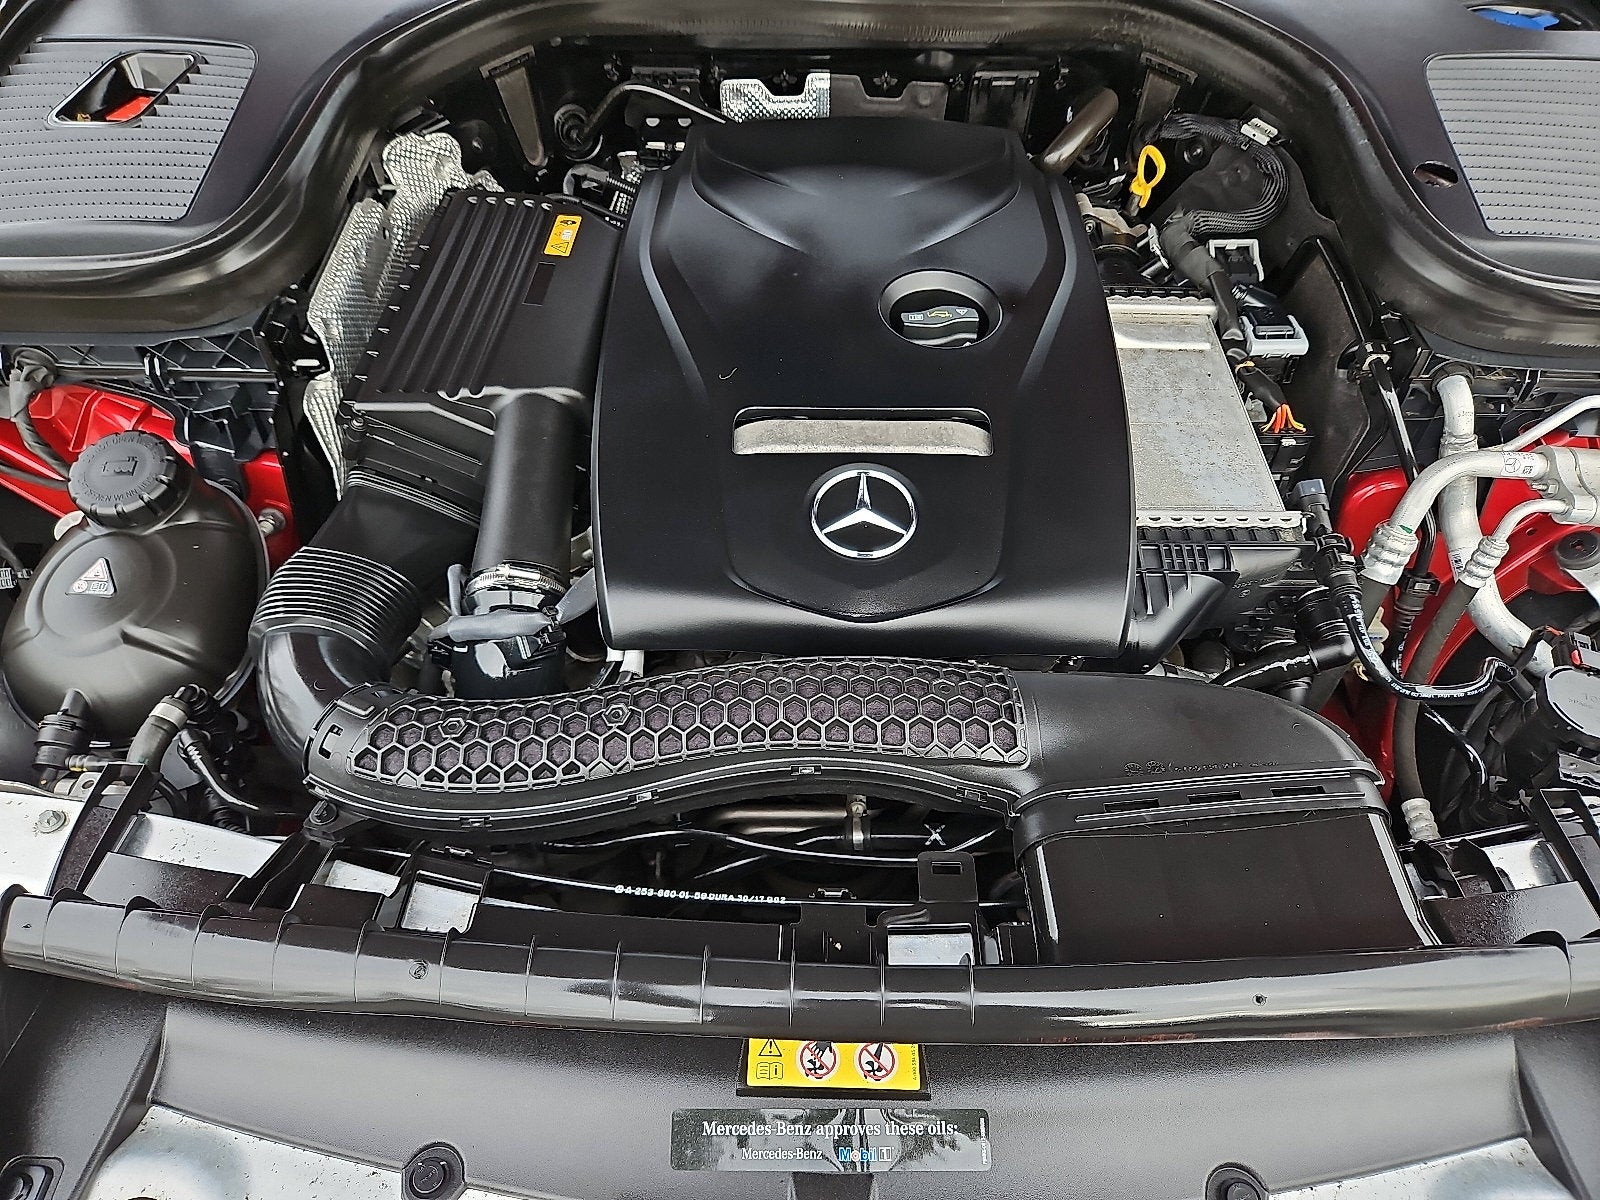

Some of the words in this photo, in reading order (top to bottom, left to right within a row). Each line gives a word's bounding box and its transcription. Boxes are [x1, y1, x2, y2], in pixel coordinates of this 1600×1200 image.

[702, 1121, 812, 1136] Mercedes-Benz
[815, 1123, 881, 1140] approves
[885, 1120, 925, 1136] these
[927, 1120, 958, 1136] oils:
[741, 1147, 823, 1160] Mercedes-Benz
[838, 1146, 878, 1161] Mobil
